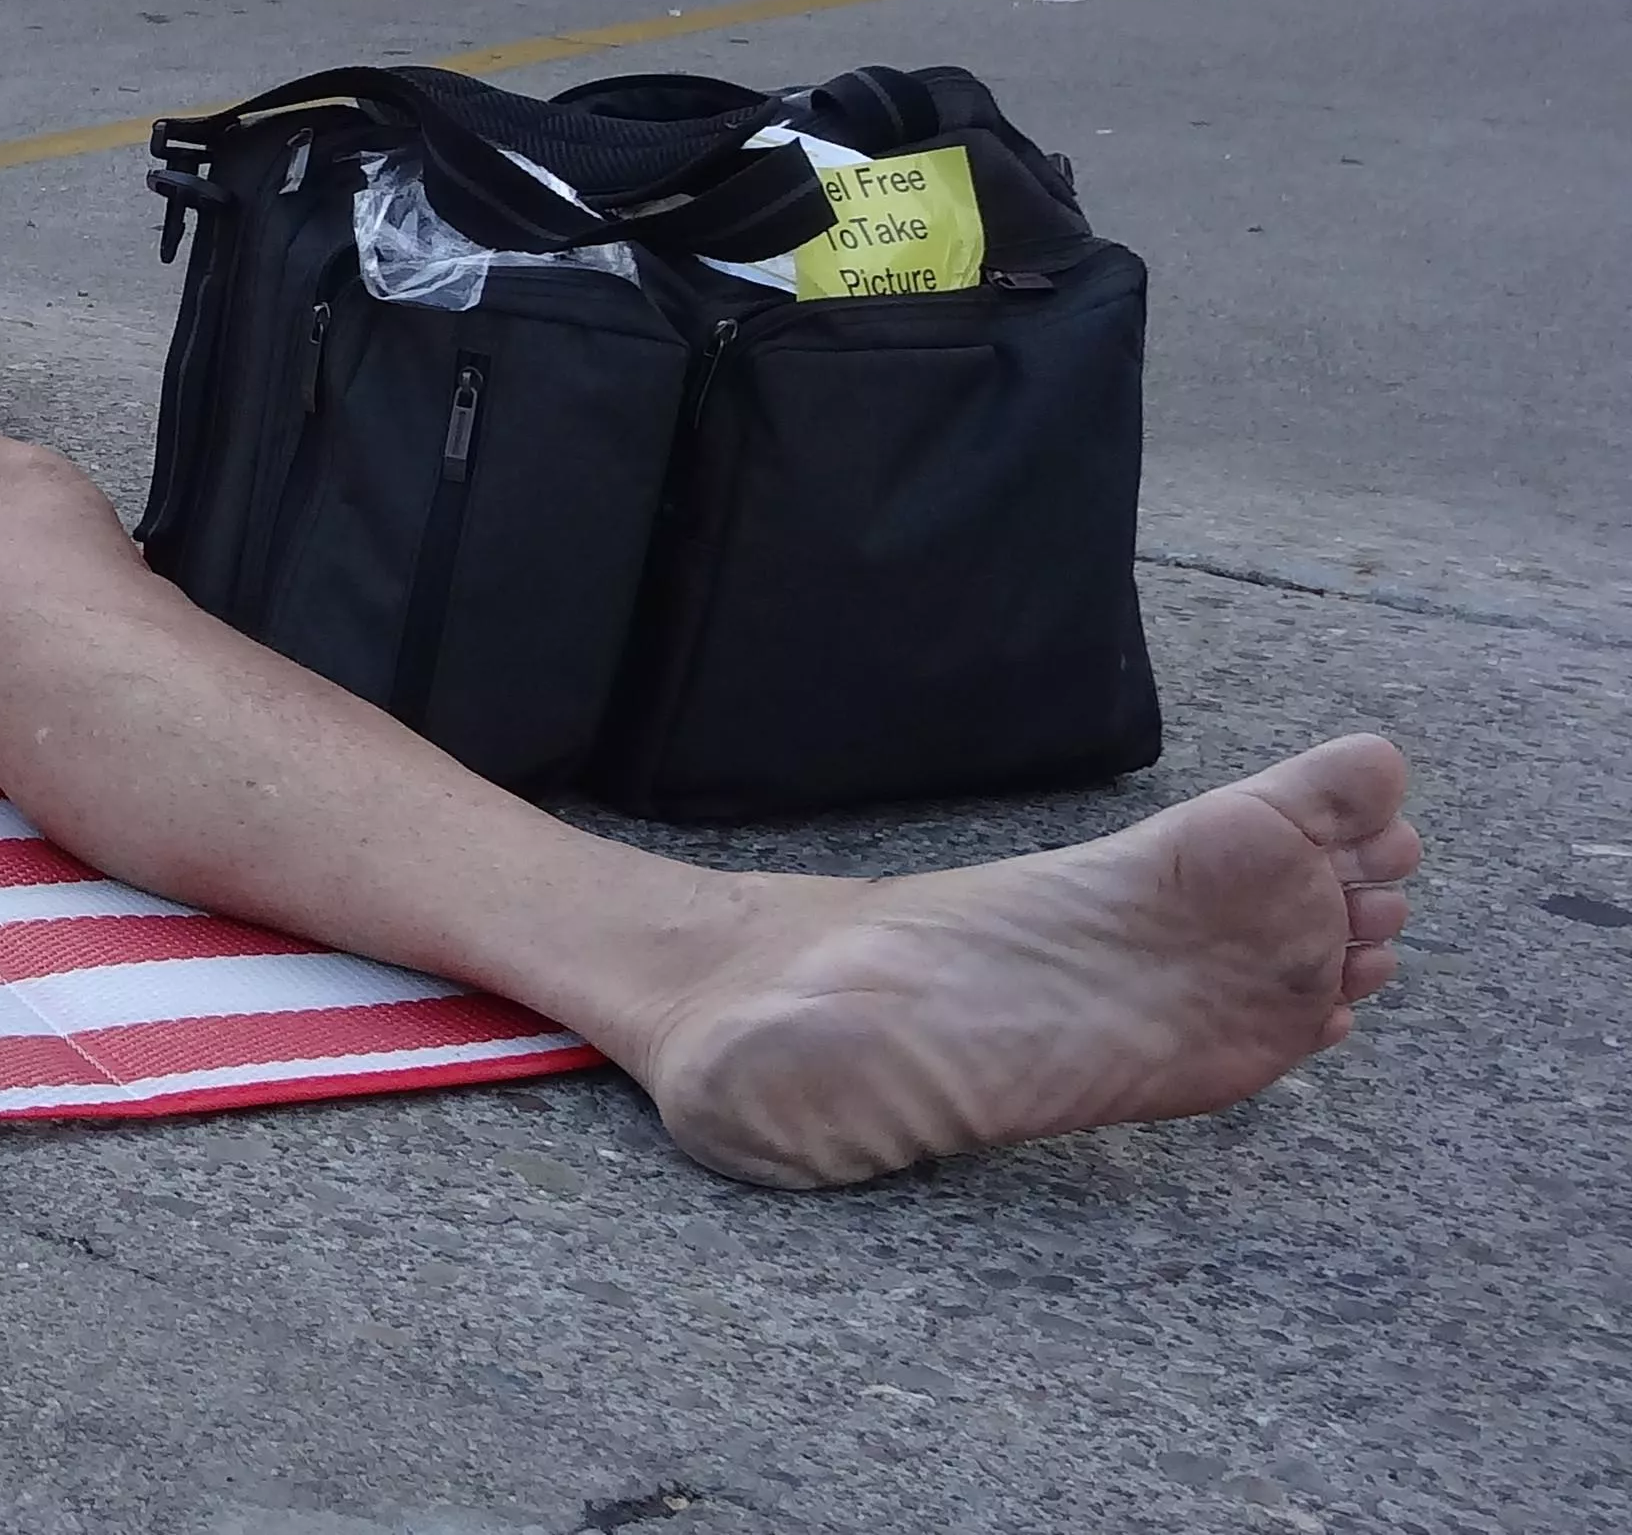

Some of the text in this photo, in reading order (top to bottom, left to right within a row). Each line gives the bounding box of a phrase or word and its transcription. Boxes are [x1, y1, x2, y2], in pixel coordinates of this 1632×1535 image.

[825, 167, 927, 202] el Free
[839, 267, 938, 297] Picture
